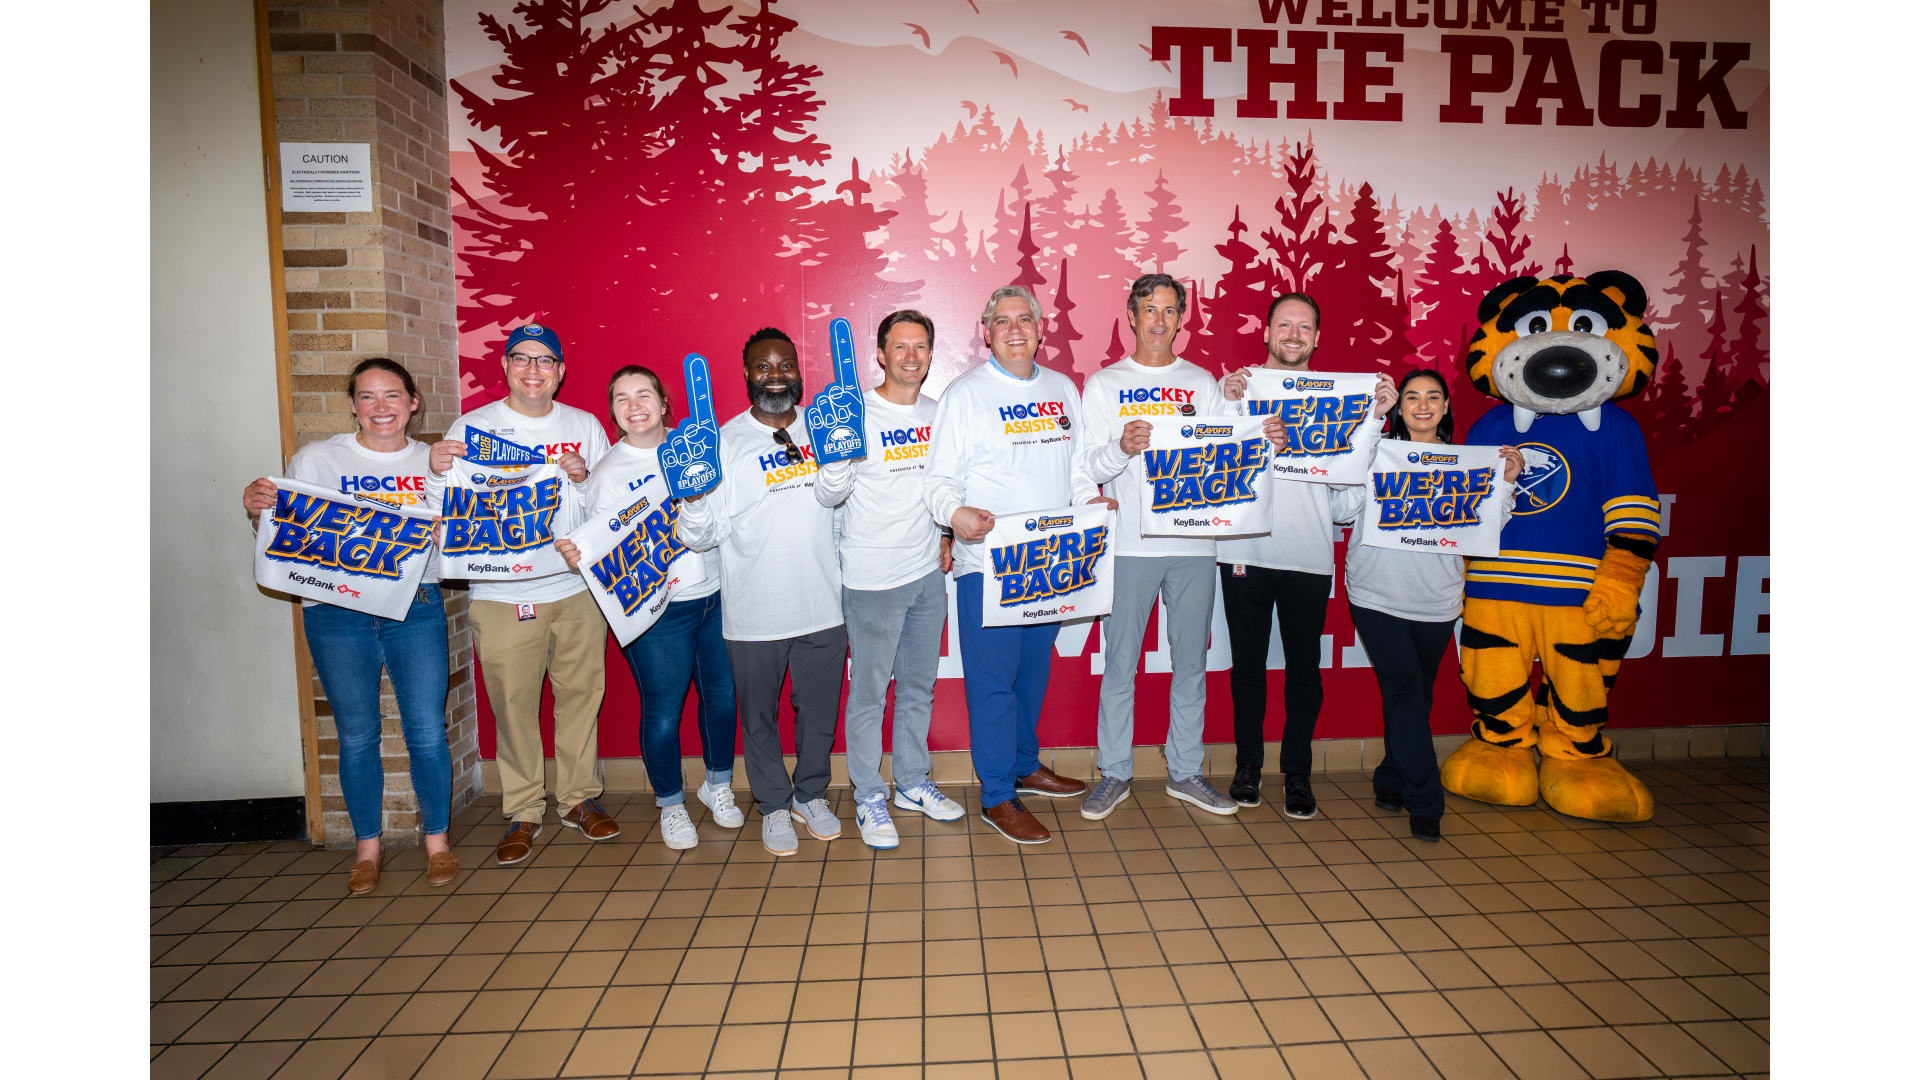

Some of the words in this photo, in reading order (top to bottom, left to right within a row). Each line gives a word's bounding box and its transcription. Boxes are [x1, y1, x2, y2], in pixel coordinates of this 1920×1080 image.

[1259, 0, 1565, 34] WELCOME
[1588, 0, 1657, 35] TO
[1152, 26, 1405, 122] THE
[1440, 34, 1751, 130] PACK
[302, 154, 349, 164] CAUTION
[1119, 387, 1196, 404] HOCKEY
[998, 401, 1065, 422] HOCKEY
[1118, 403, 1176, 418] ASSISTS
[1004, 417, 1056, 435] ASSISTS
[1196, 427, 1232, 435] PLAYOFFS
[479, 435, 491, 461] 2026
[491, 438, 530, 462] PLAYOFFS
[1281, 422, 1356, 455] ACK
[1143, 436, 1266, 482] WE'RE
[1274, 464, 1308, 475] KeyBank
[1422, 455, 1457, 463] PLAYOFFS
[341, 475, 425, 493] HOCKE
[766, 460, 819, 487] ASSISTS
[1373, 467, 1492, 500] WE'RE
[441, 477, 560, 521] WE'RE
[1151, 467, 1256, 511] BACK
[273, 488, 436, 550] WE'RE
[620, 499, 648, 522] PLAYOFFS
[1378, 494, 1481, 528] BACK
[443, 508, 555, 553] BACK
[1040, 518, 1073, 527] PLAYOFFS
[1174, 518, 1210, 527] KeyBank
[266, 521, 414, 577] BACK
[990, 524, 1106, 577] WE'RE
[1401, 537, 1438, 547] KeyBank
[467, 563, 510, 574] KeyBank
[288, 571, 335, 592] KeyBank
[1000, 556, 1098, 605] BACK
[1023, 607, 1058, 618] KeyBank
